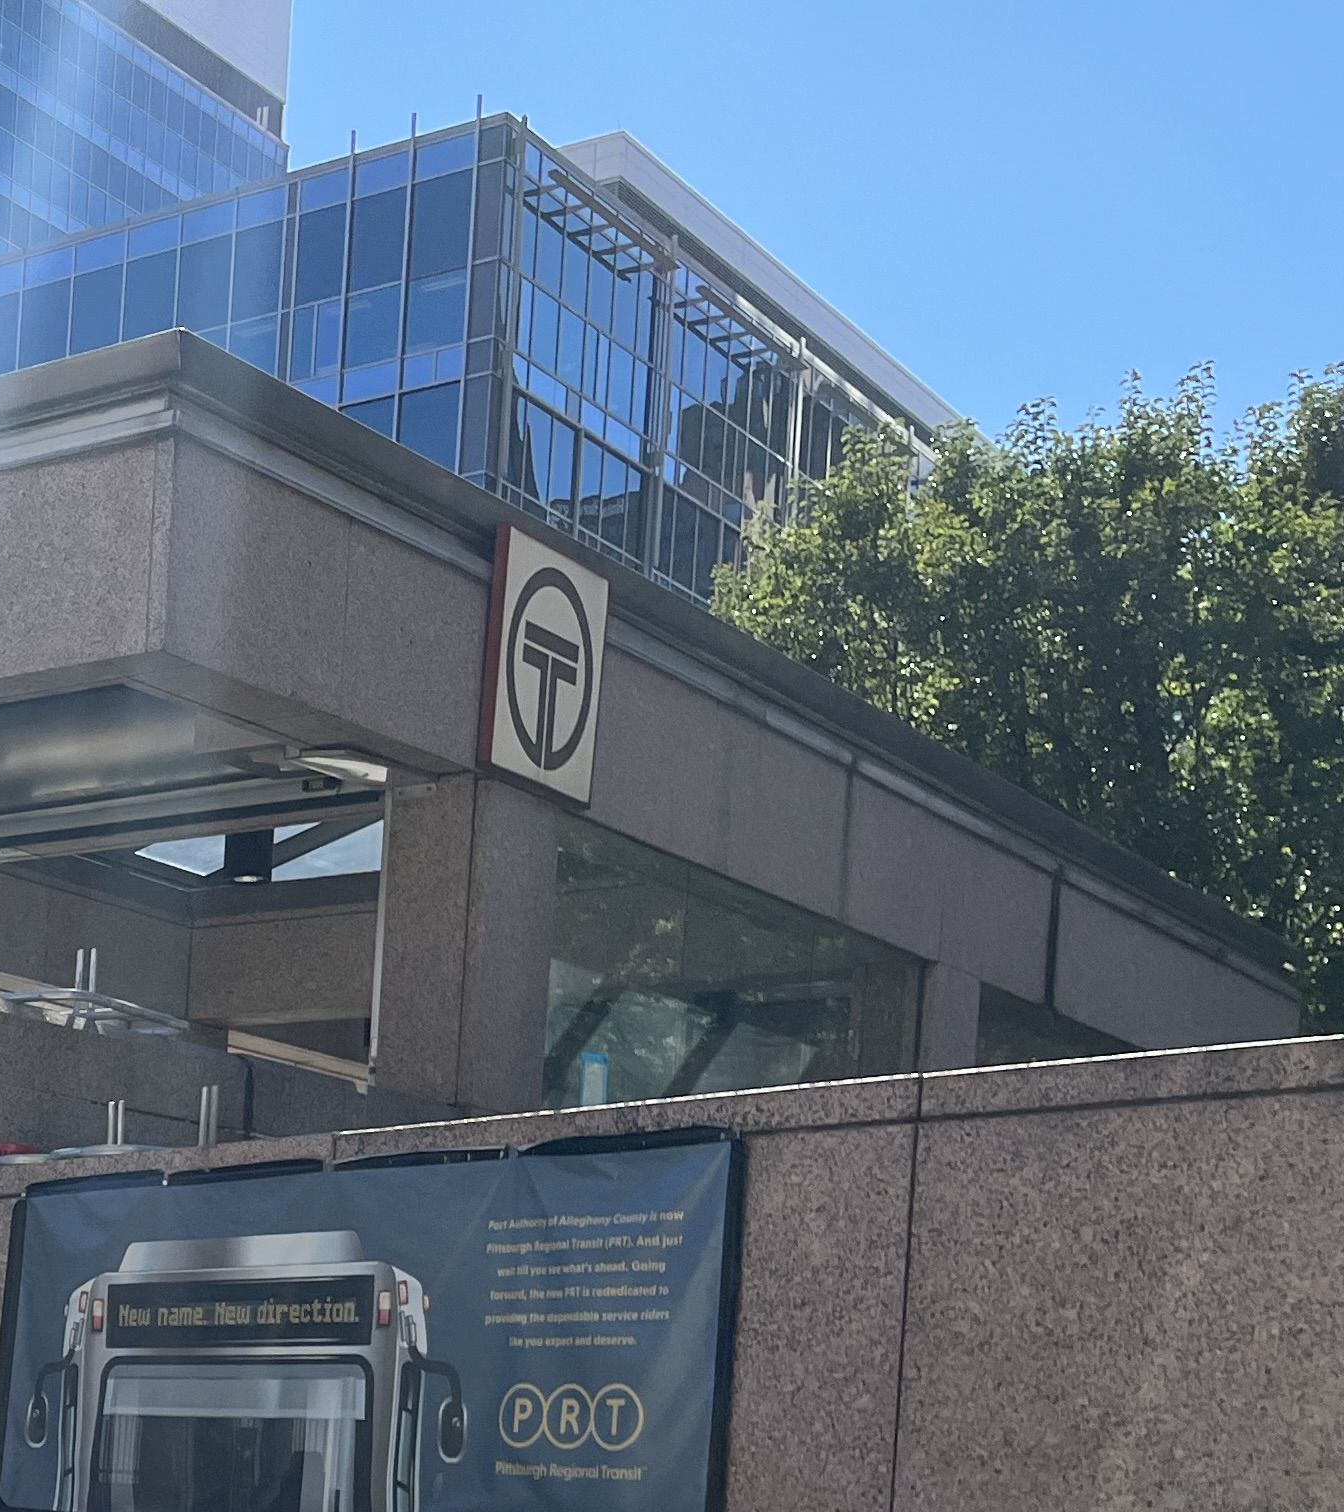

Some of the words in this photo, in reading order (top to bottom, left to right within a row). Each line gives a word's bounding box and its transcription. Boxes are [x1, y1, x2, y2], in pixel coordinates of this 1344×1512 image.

[559, 1215, 610, 1228] Allegheny
[613, 1213, 648, 1224] County
[649, 1210, 657, 1220] is
[660, 1211, 684, 1221] now
[486, 1242, 532, 1254] Pittsburgh
[534, 1240, 570, 1253] Regional
[571, 1238, 603, 1249] Transit
[604, 1235, 634, 1250] (PRT).
[636, 1235, 660, 1246] And
[661, 1234, 684, 1248] just
[530, 1266, 547, 1277] you
[562, 1262, 592, 1273] what's
[594, 1261, 629, 1272] ahead.
[632, 1260, 666, 1274] Going
[529, 1288, 545, 1299] the
[564, 1286, 580, 1297] PRT
[592, 1285, 657, 1297] rededicated
[658, 1285, 670, 1296] to
[118, 1304, 151, 1327] New
[157, 1304, 208, 1327] name.
[214, 1302, 250, 1325] New
[256, 1297, 360, 1325] direction.
[484, 1314, 528, 1326] providing
[530, 1312, 545, 1322] the
[546, 1310, 600, 1324] dependable
[602, 1310, 638, 1320] service
[640, 1308, 670, 1320] riders
[524, 1338, 544, 1348] you
[545, 1336, 573, 1348] expect
[574, 1336, 592, 1346] and
[594, 1334, 636, 1346] deserve.
[495, 1460, 546, 1480] Pittsburgh
[550, 1463, 598, 1481] Regional
[600, 1464, 642, 1481] Transit
